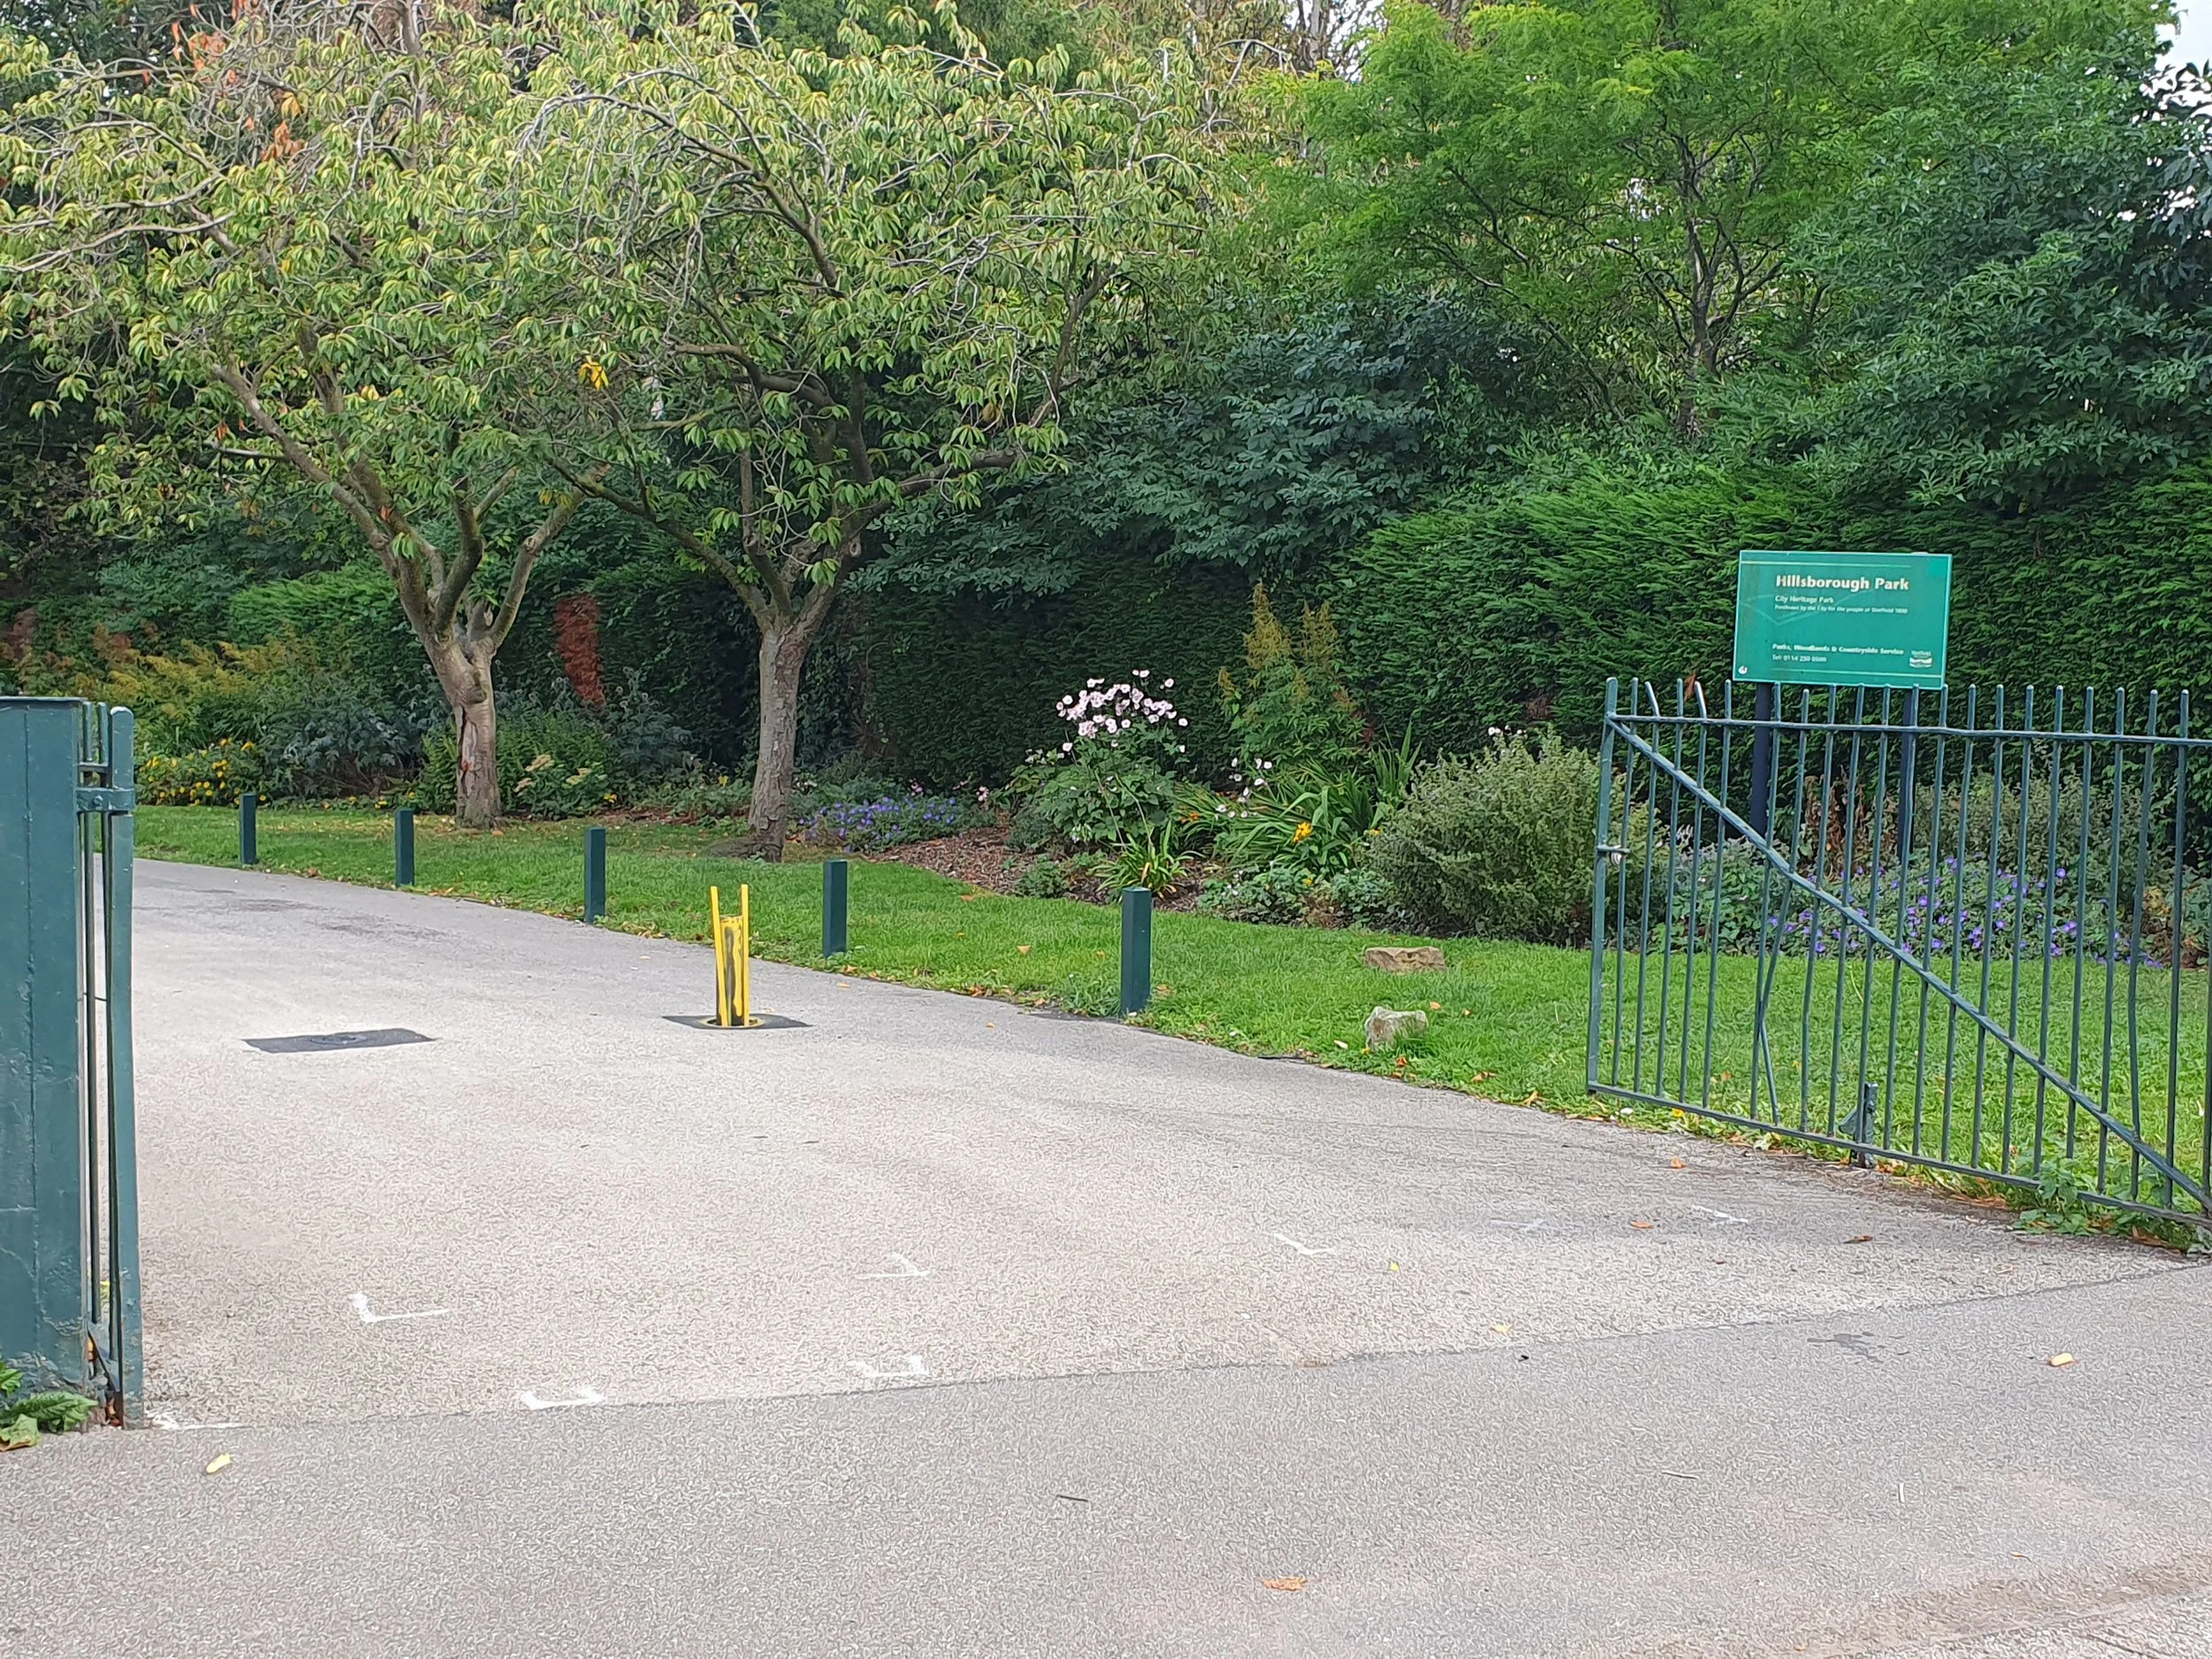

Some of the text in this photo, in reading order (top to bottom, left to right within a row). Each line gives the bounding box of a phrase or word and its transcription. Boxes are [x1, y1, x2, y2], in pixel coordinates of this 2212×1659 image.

[1776, 574, 1909, 592] Hillsborough Park
[1775, 595, 1788, 603] City
[1789, 595, 1817, 604] Heritage
[1839, 646, 1878, 655] Countryside
